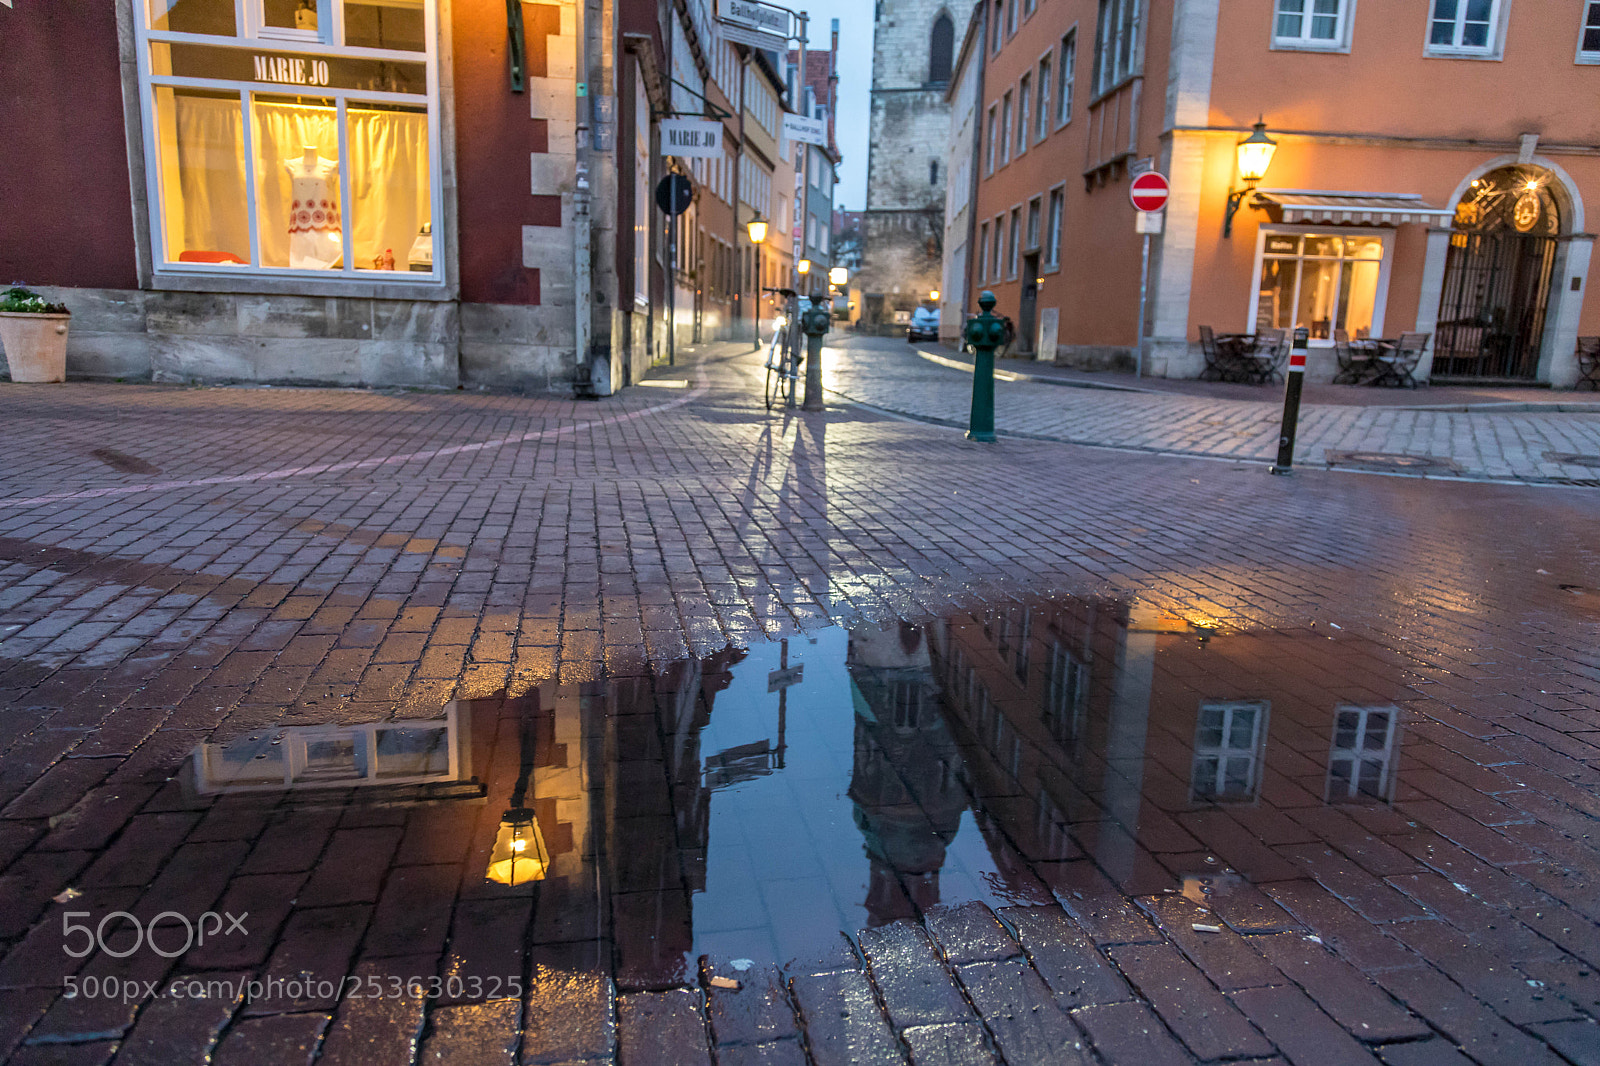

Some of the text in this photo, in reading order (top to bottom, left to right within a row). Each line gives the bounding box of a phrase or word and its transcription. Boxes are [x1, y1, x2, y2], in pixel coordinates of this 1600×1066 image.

[254, 56, 329, 86] MARIE JO
[669, 129, 715, 148] MARIE JO
